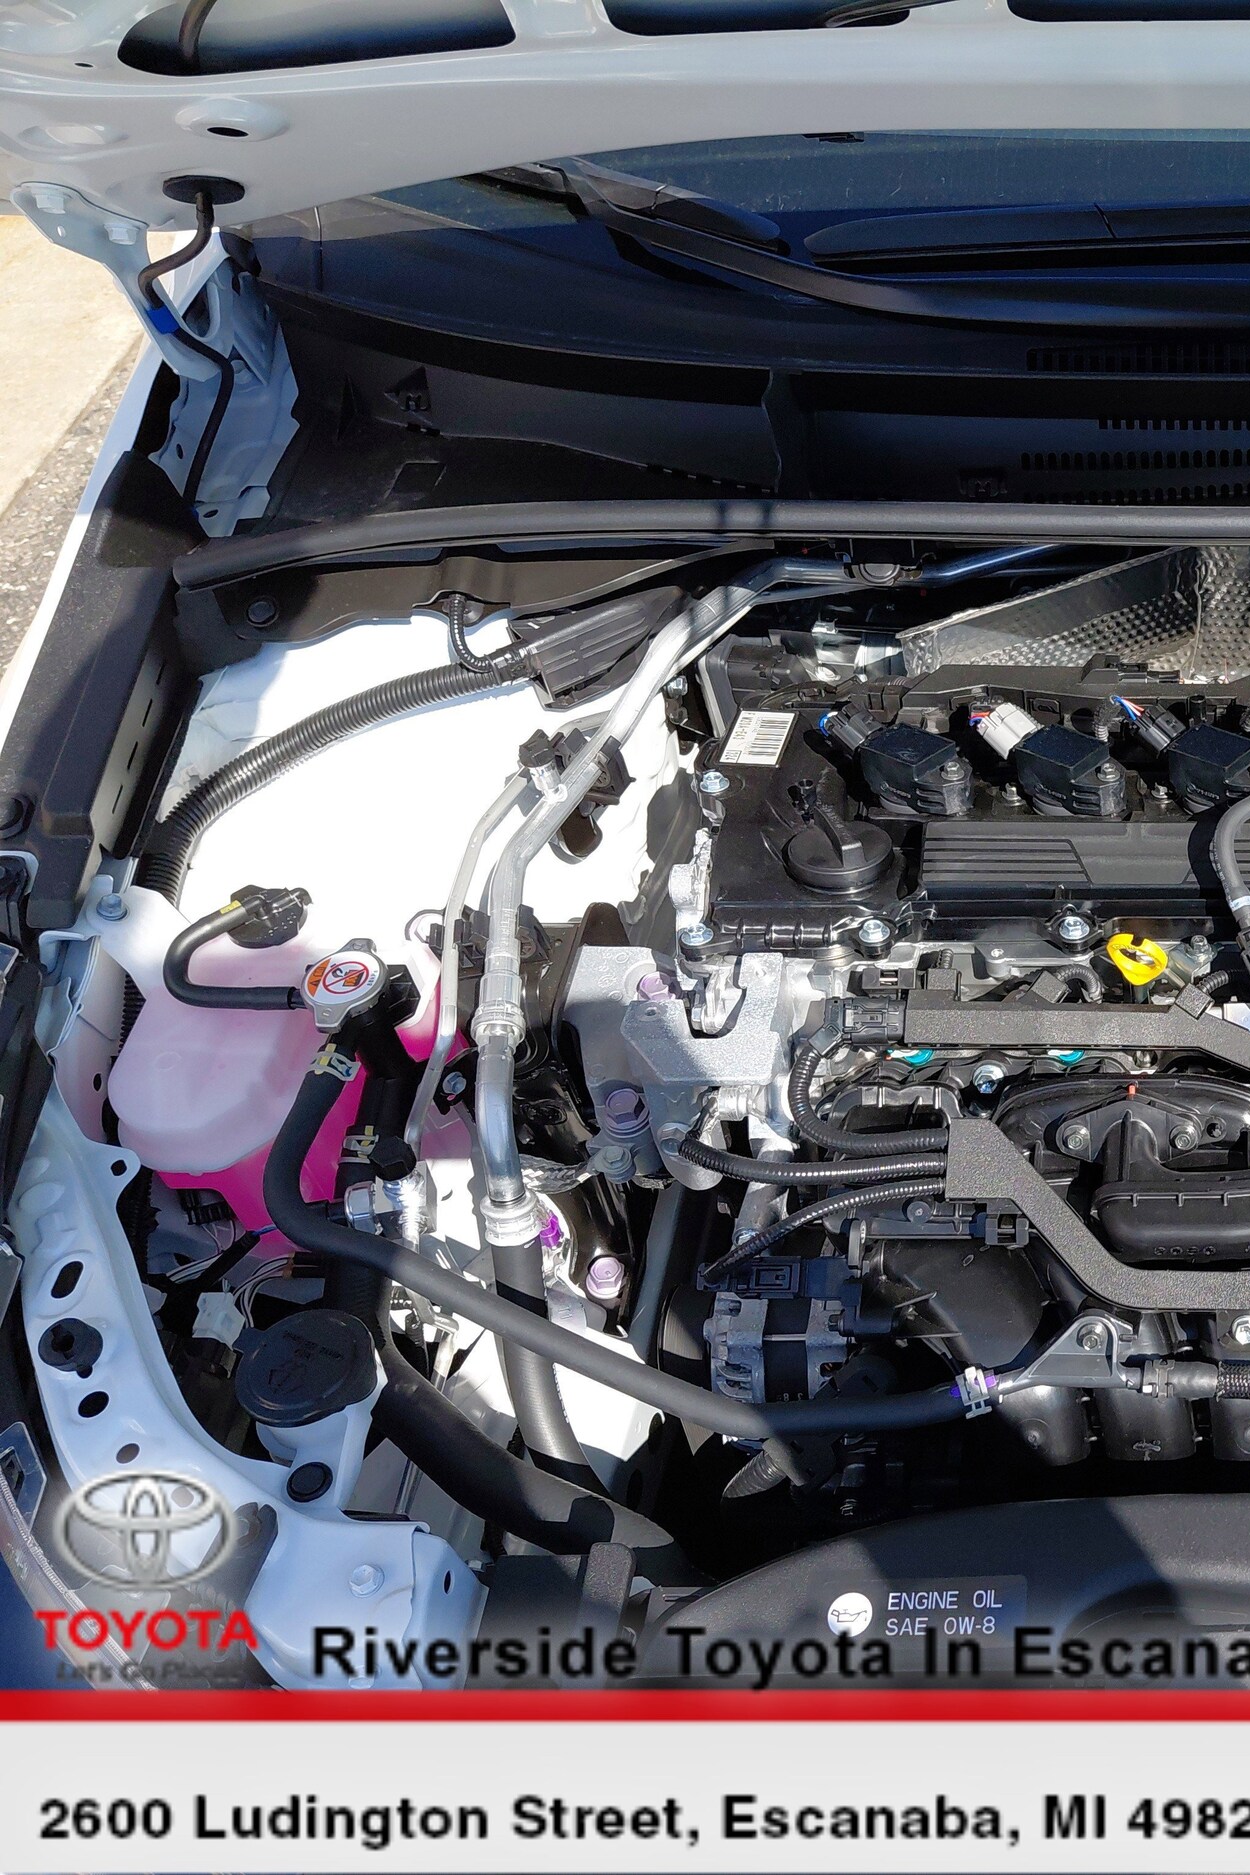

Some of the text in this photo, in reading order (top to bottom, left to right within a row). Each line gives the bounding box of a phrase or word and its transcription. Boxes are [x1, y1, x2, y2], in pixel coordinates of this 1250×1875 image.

[886, 1589, 1003, 1611] ENGINE OIL
[884, 1615, 996, 1636] SAE 0W-8
